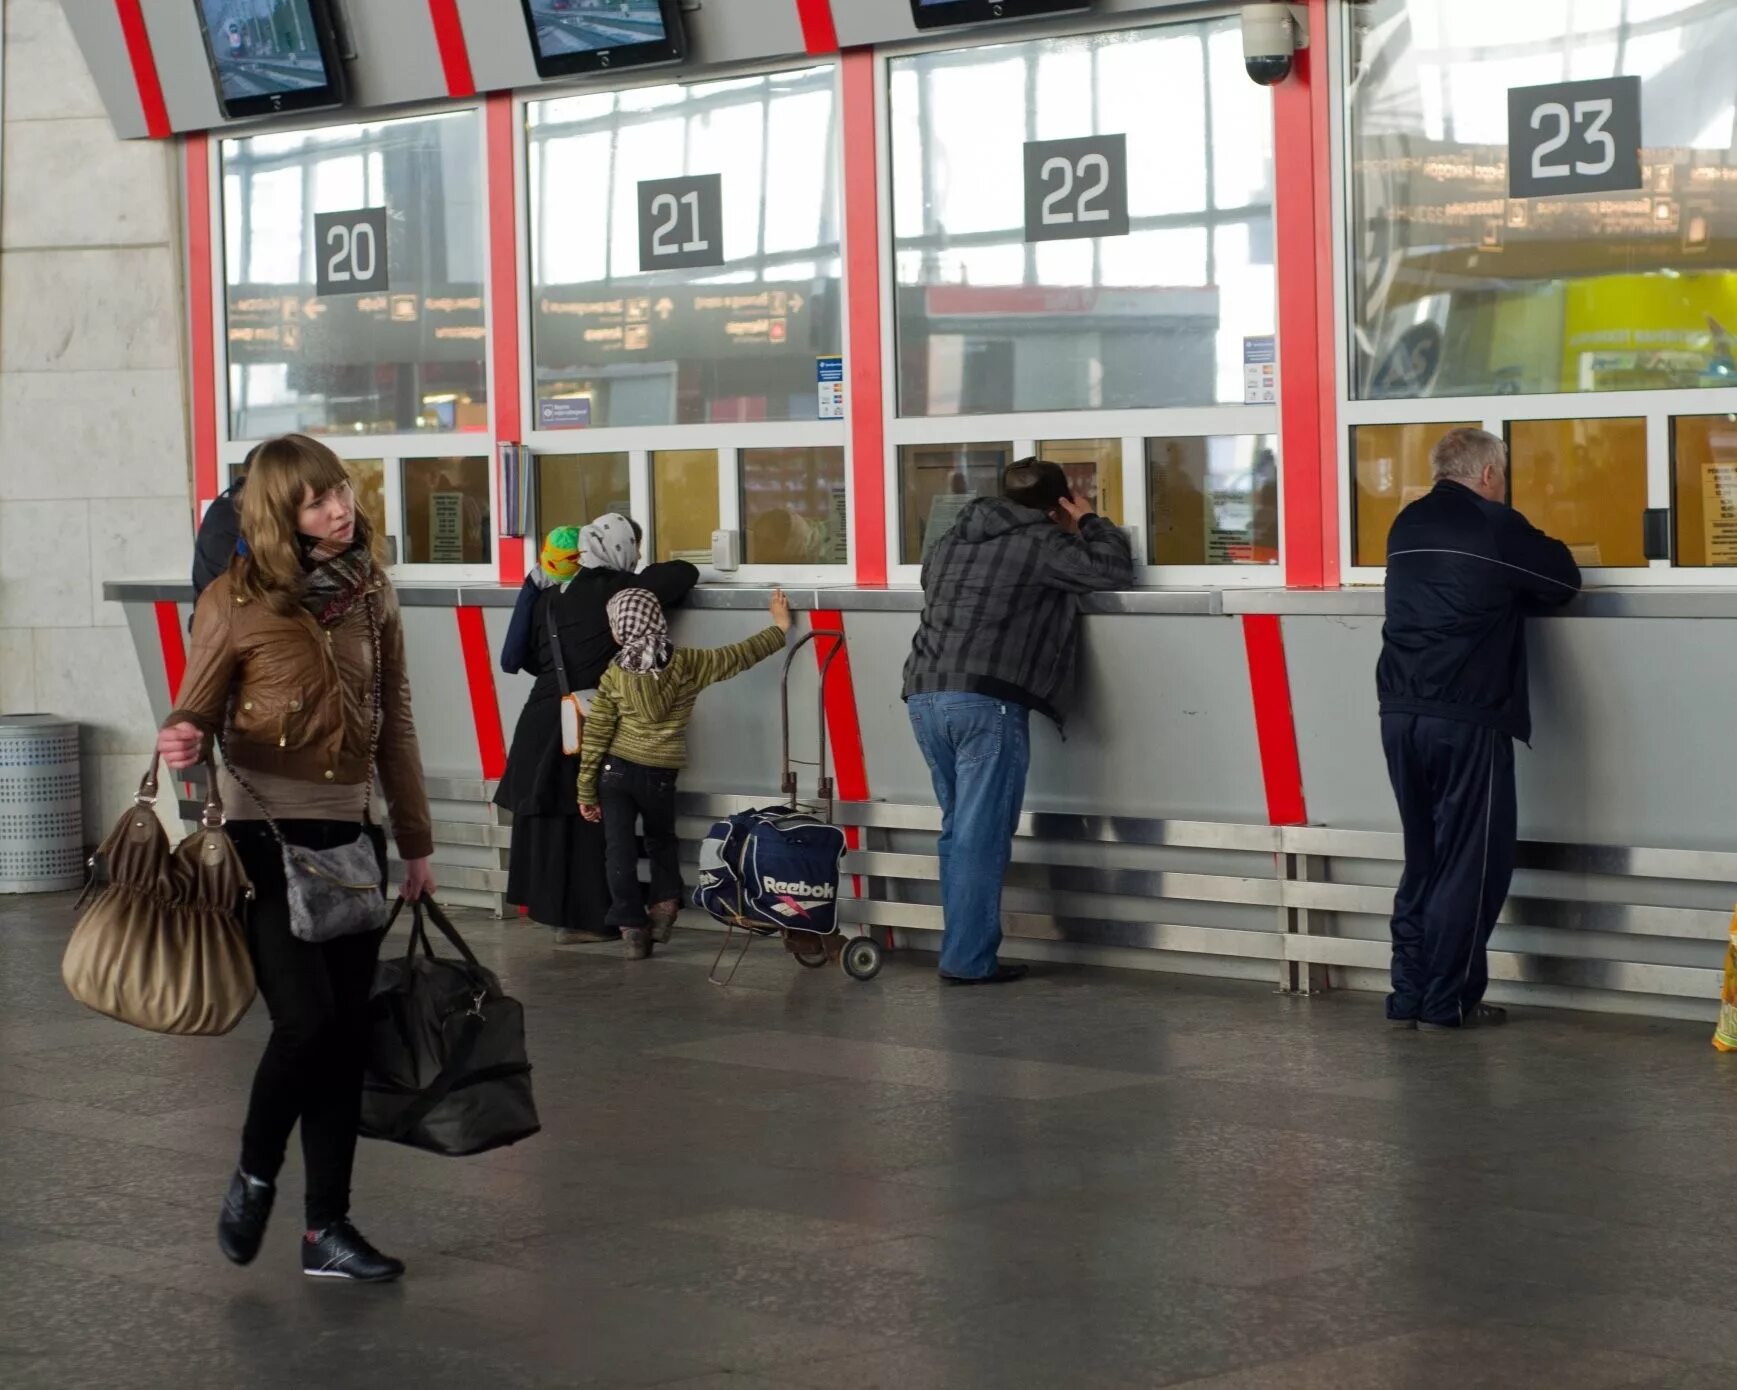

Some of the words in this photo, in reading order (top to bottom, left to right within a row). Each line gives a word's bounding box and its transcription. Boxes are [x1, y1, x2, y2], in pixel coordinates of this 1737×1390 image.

[1530, 98, 1615, 178] 23
[1041, 153, 1109, 224] 22
[327, 223, 376, 281] 20
[651, 191, 708, 255] 21
[763, 876, 834, 898] Reebok
